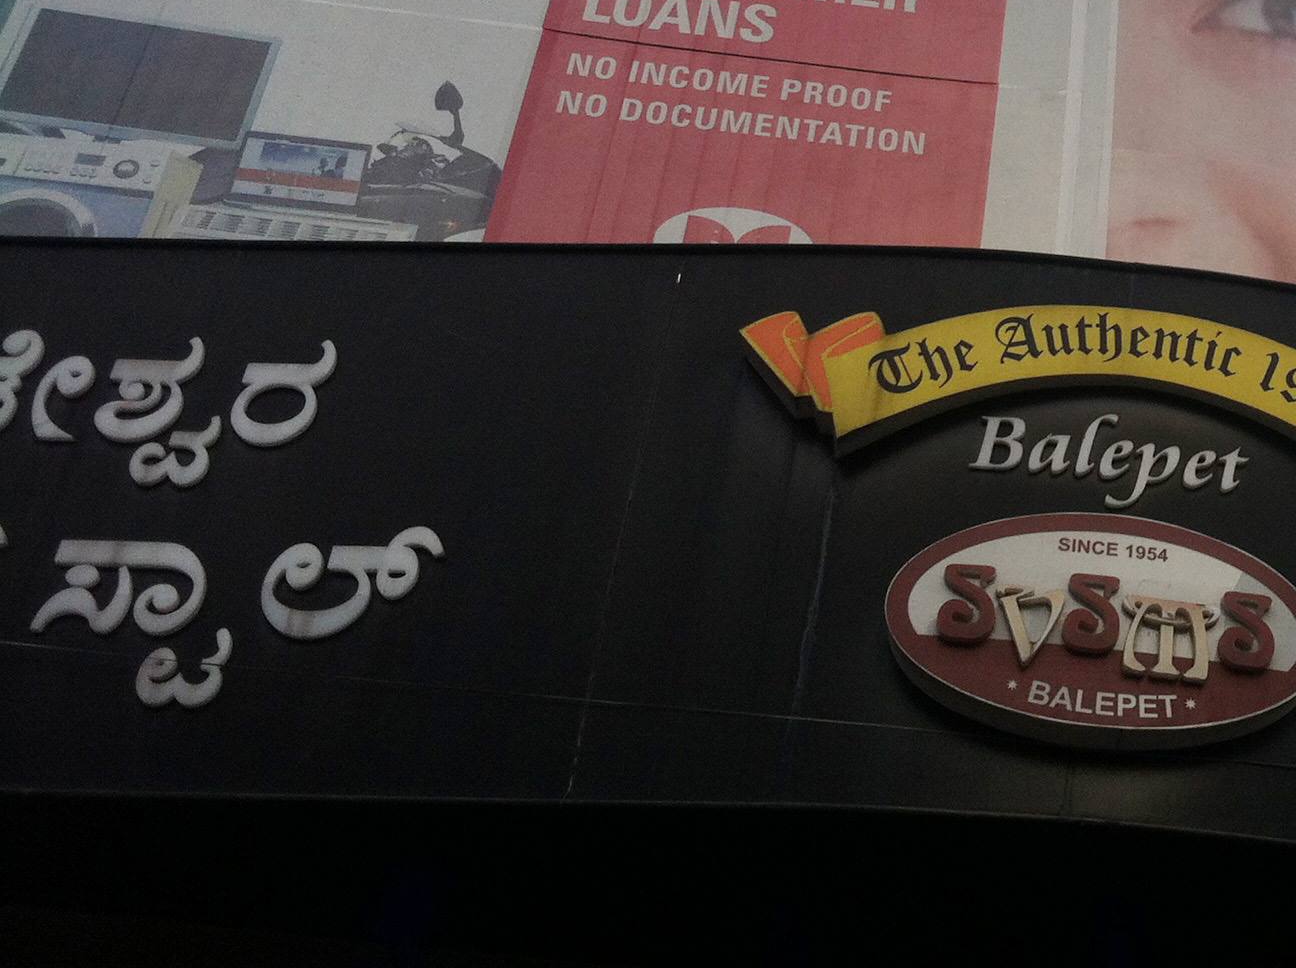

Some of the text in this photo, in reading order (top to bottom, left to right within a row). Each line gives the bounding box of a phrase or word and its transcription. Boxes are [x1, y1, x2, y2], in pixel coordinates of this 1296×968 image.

[566, 52, 893, 113] NO INCOME PROOF
[555, 90, 926, 156] NO DOCUMENTATION
[868, 335, 978, 395] The
[995, 312, 1242, 378] Authentic
[970, 413, 1249, 509] Balepet
[1057, 536, 1169, 563] SINCE 1954
[1028, 678, 1178, 719] BALEPET
